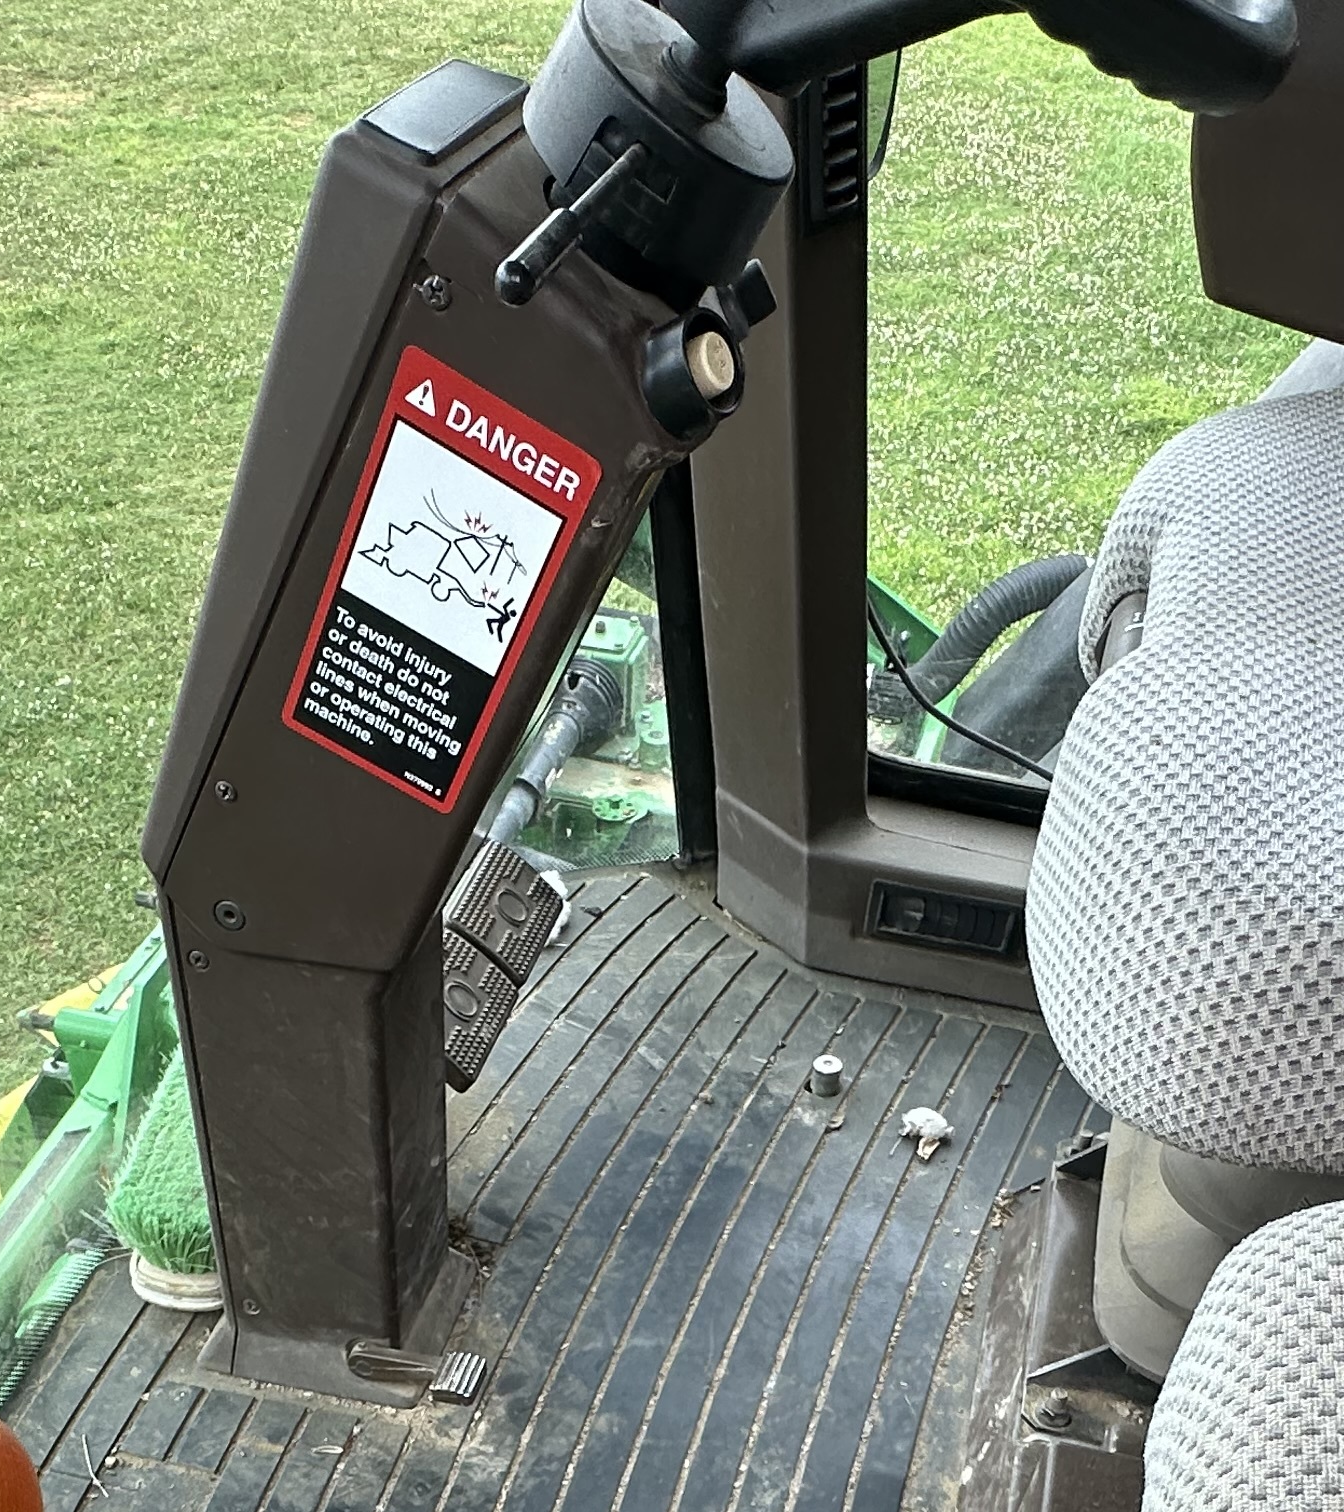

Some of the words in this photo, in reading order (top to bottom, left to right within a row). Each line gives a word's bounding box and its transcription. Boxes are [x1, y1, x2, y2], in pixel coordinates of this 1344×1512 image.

[446, 399, 580, 501] DANGER
[328, 628, 348, 645] or
[349, 640, 395, 674] death
[396, 668, 419, 687] do
[421, 681, 450, 705] not
[336, 605, 356, 629] To
[357, 623, 404, 657] avoid
[404, 647, 452, 687] injury
[303, 697, 374, 745] machine.
[310, 681, 329, 698] or
[330, 693, 405, 744] operating
[407, 734, 437, 760] this
[315, 660, 355, 693] lines
[357, 686, 400, 719] when
[402, 712, 462, 756] moving
[322, 646, 383, 688] contact
[383, 682, 457, 730] electrical
